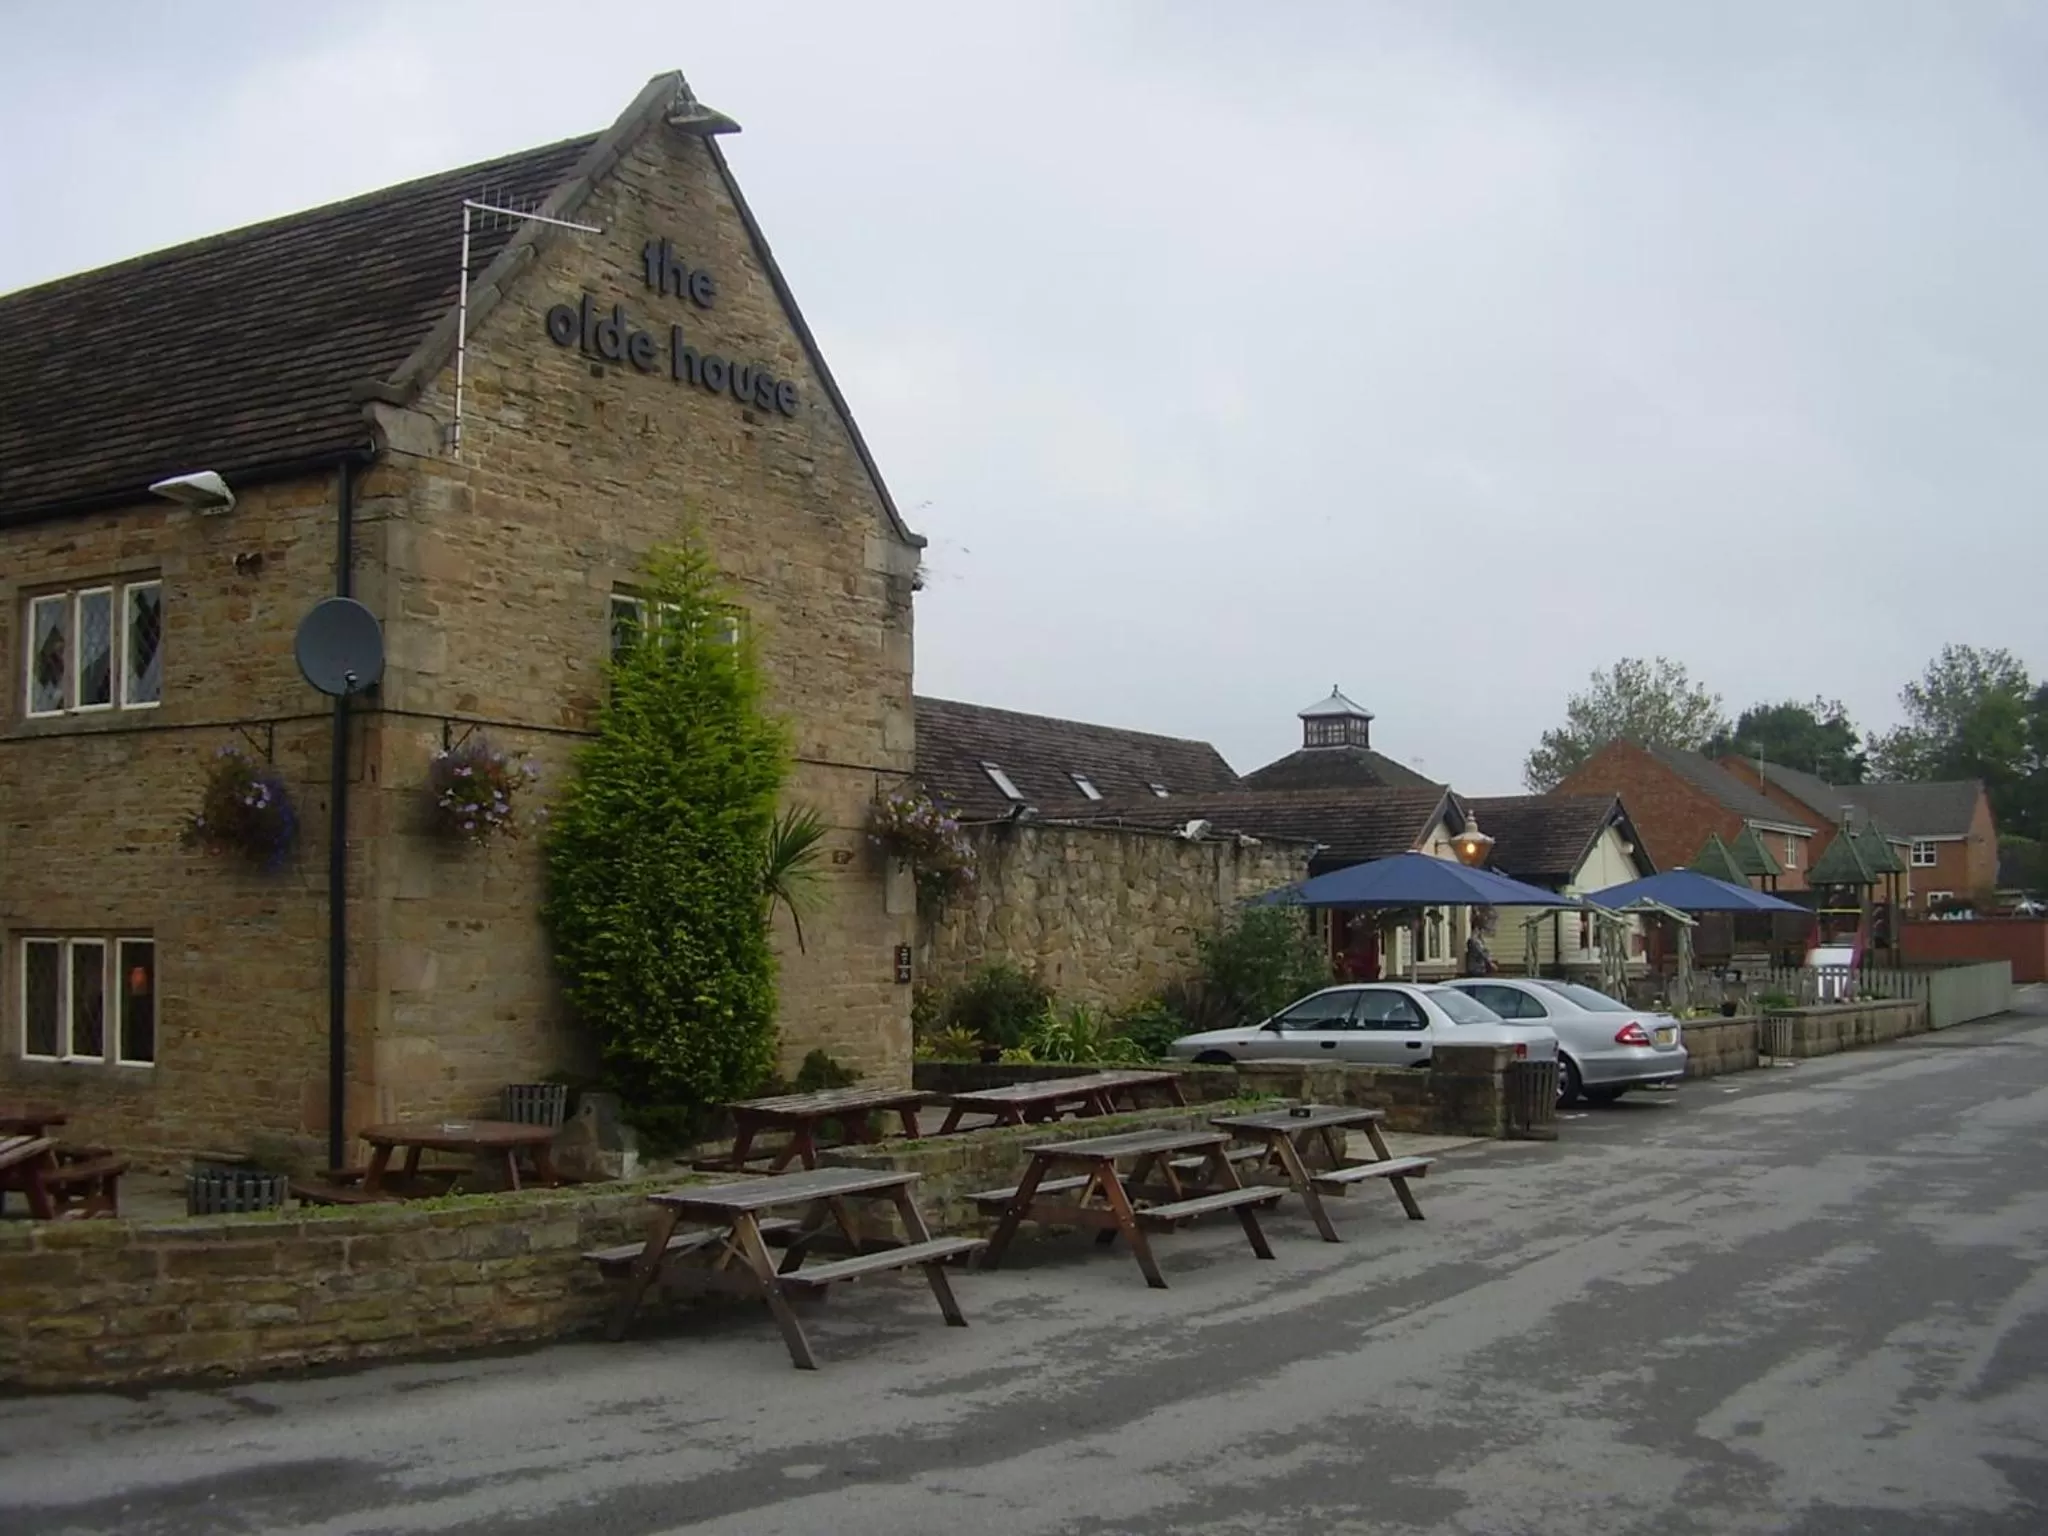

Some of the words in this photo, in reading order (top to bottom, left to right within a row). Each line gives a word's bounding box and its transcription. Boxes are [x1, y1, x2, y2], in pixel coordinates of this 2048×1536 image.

[643, 237, 716, 309] the
[547, 293, 656, 373] olde
[671, 325, 800, 418] house
